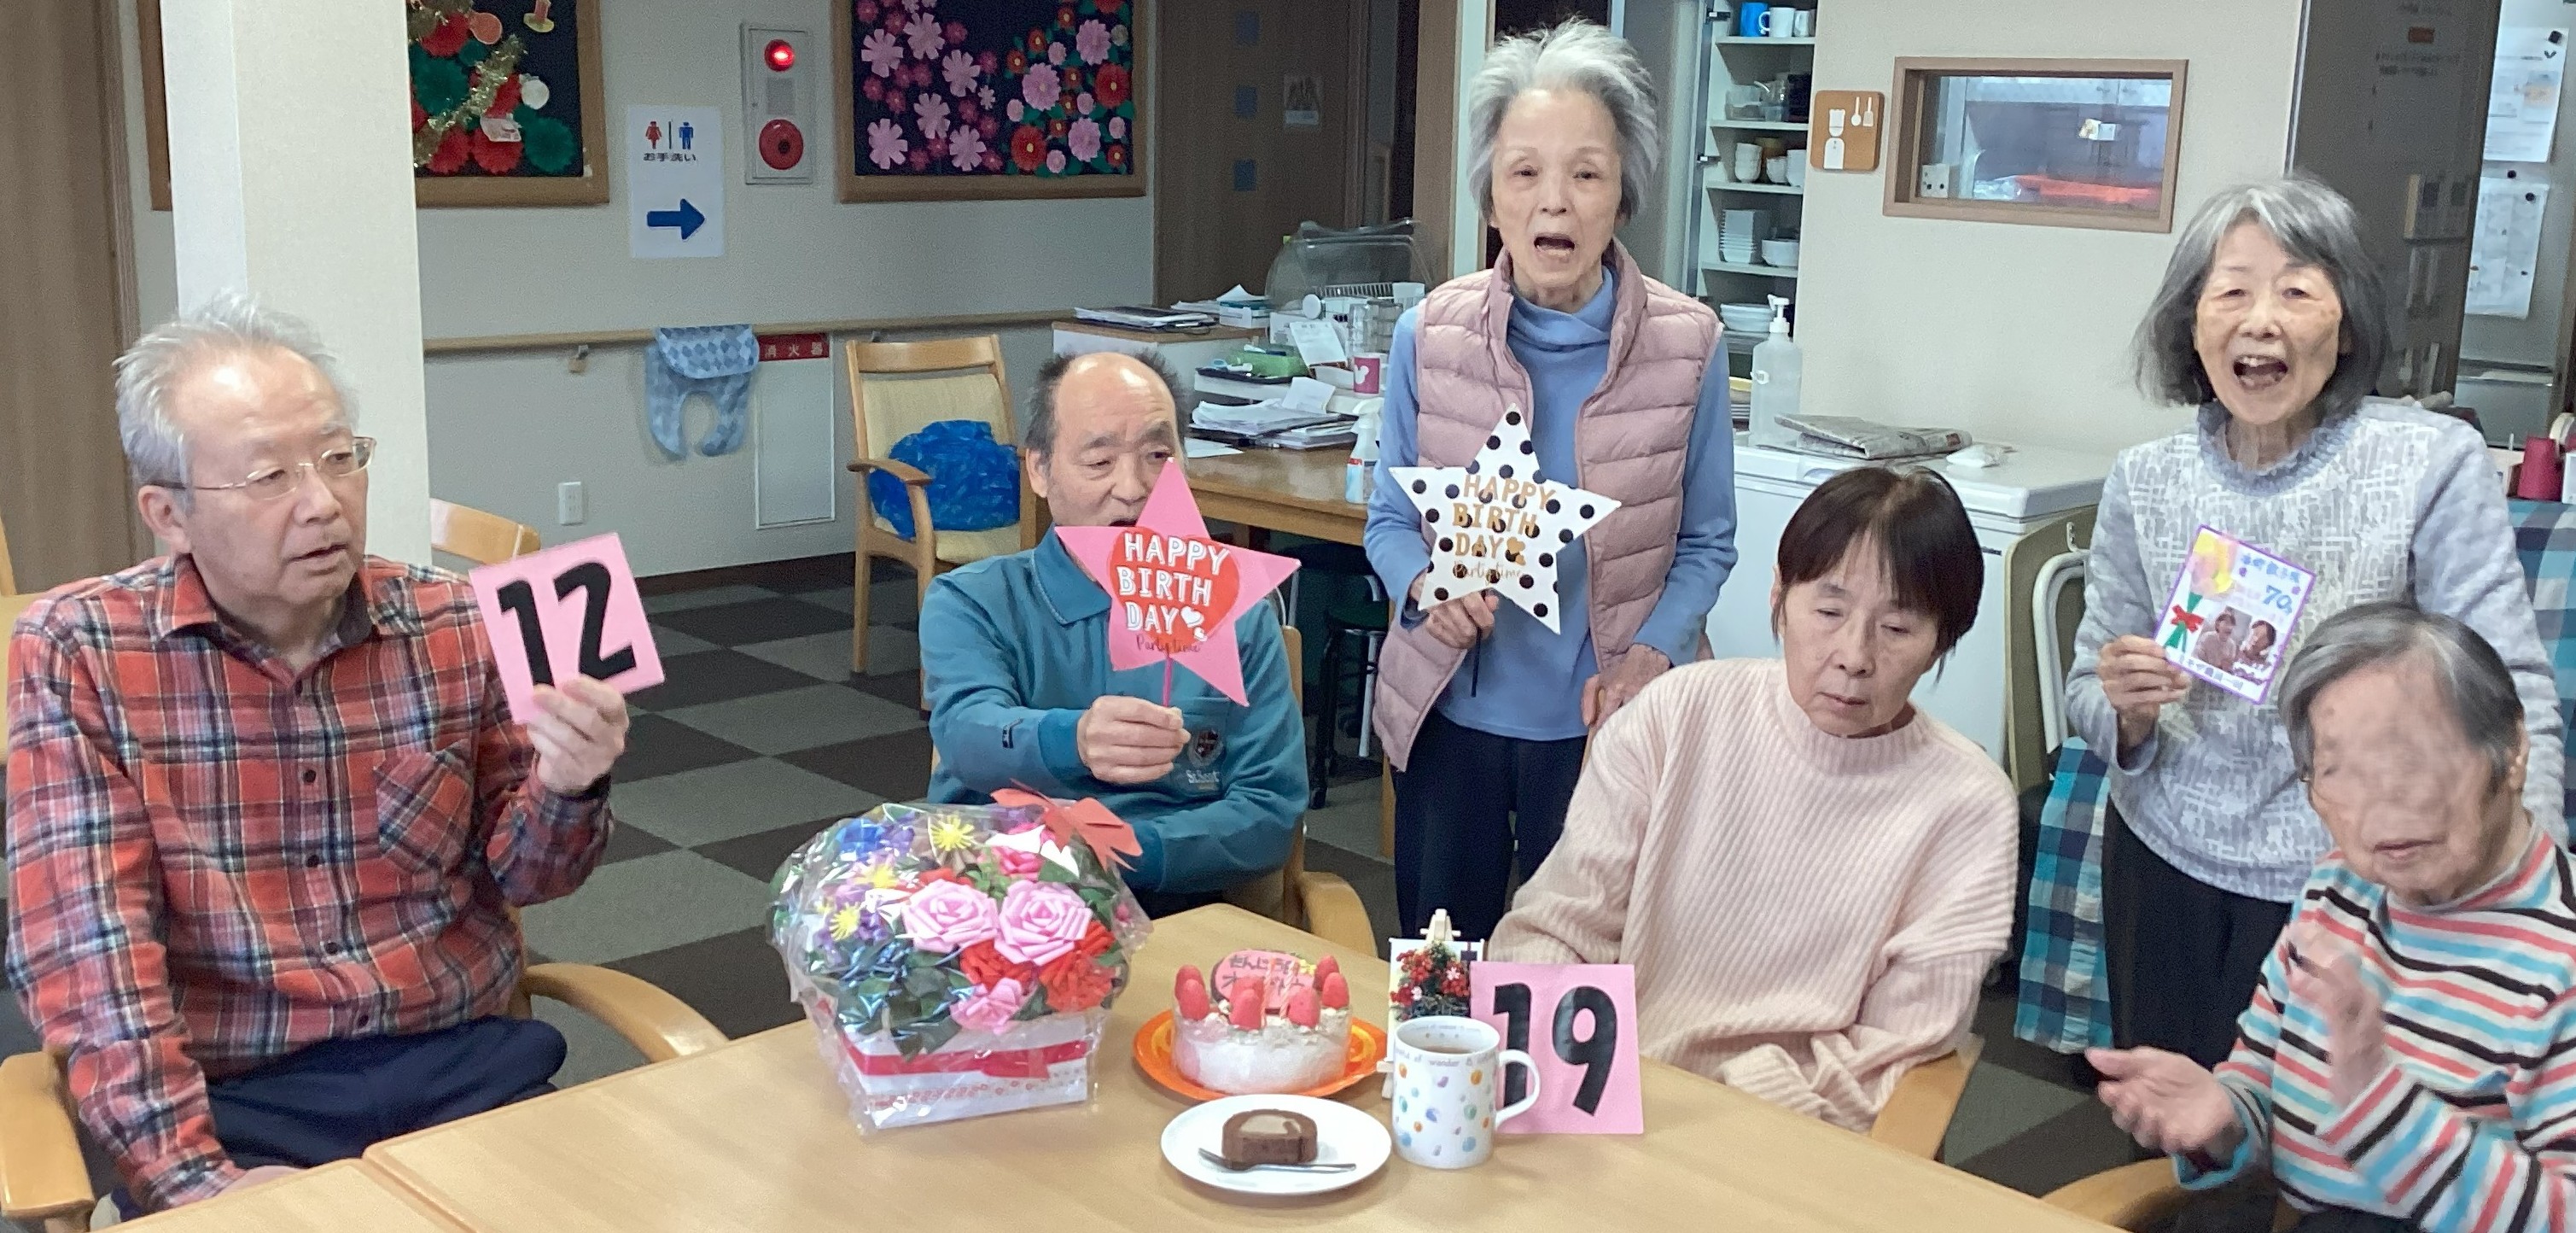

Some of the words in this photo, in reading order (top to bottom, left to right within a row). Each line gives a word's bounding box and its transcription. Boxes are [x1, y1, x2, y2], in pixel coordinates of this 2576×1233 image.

[643, 152, 697, 162] お手洗い
[765, 342, 824, 359] 消火器
[1463, 474, 1557, 511] HAPPY
[1453, 502, 1539, 536] BIRTH
[1123, 531, 1232, 576] HAPPY
[1454, 531, 1505, 560] DAY
[1116, 565, 1213, 607] BIRTH
[497, 562, 637, 687] 12
[1125, 601, 1180, 634] DAY
[1494, 983, 1618, 1116] 19
